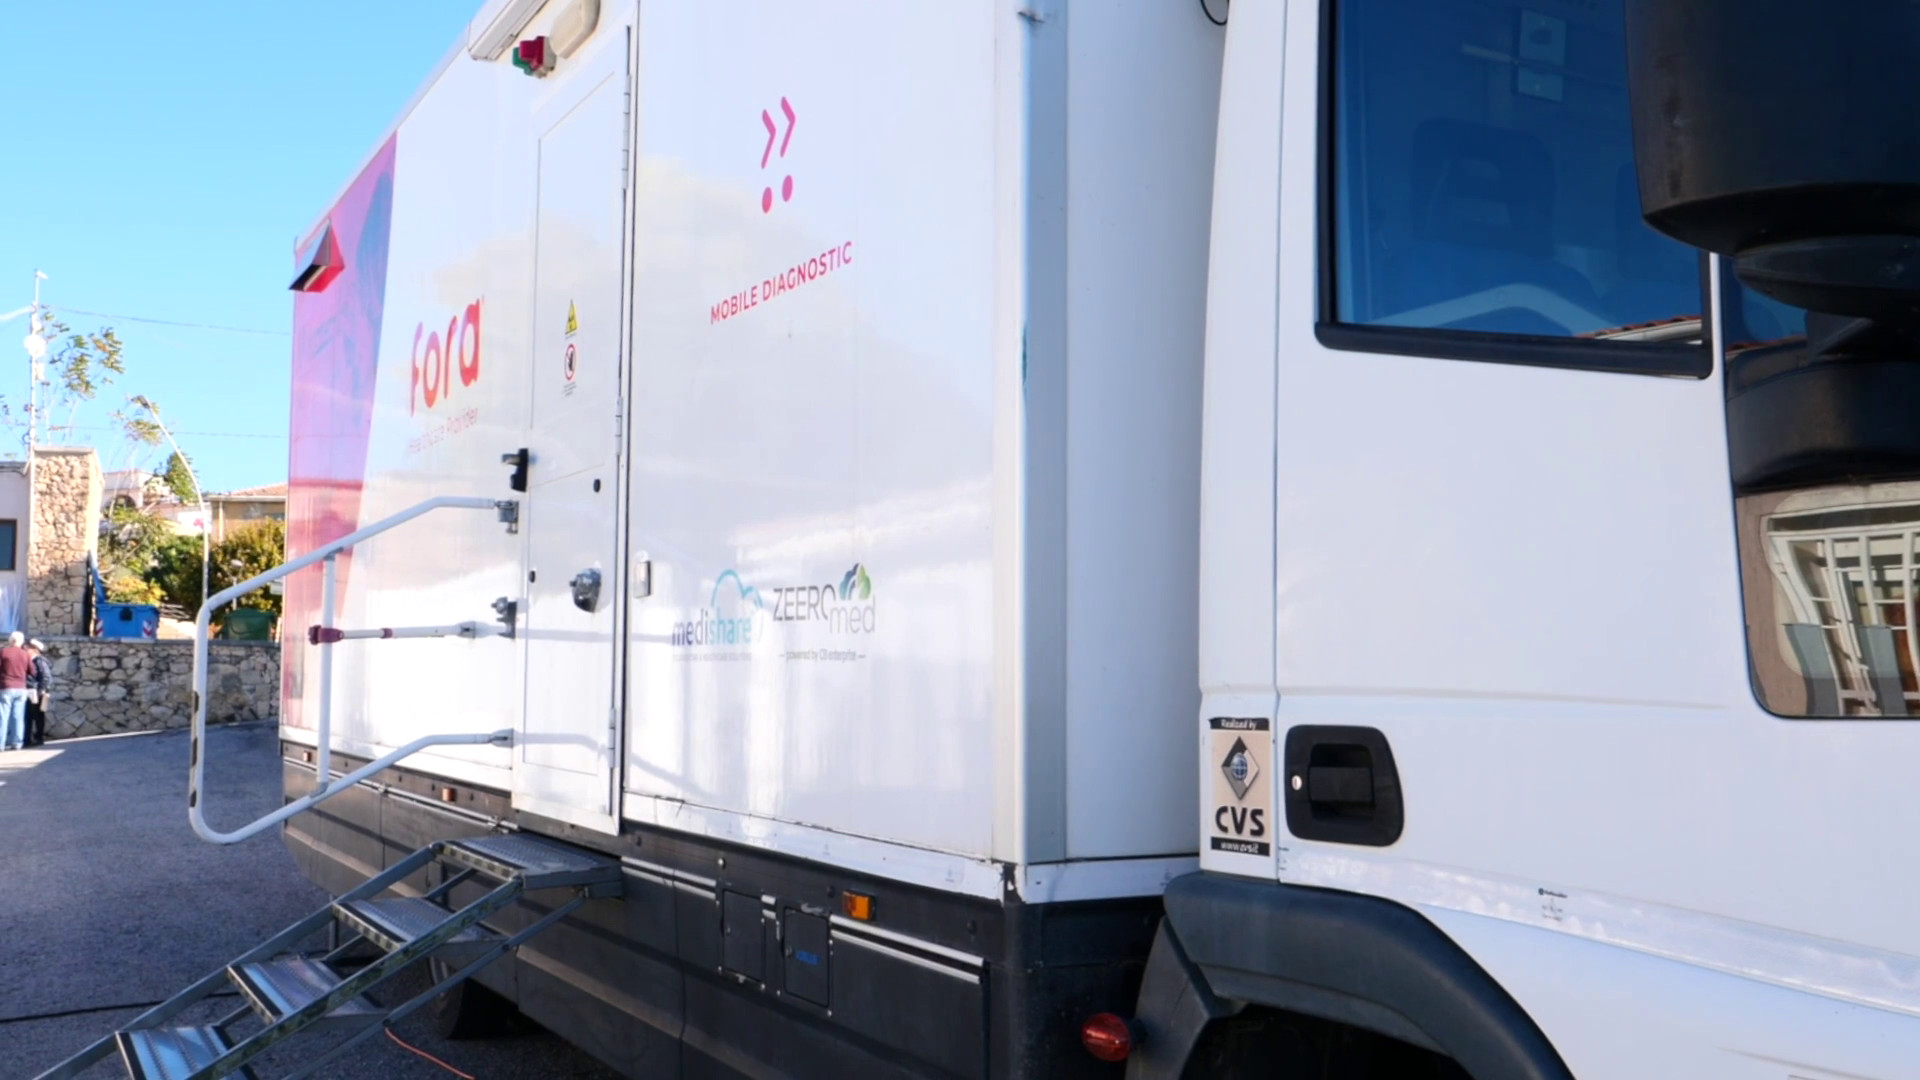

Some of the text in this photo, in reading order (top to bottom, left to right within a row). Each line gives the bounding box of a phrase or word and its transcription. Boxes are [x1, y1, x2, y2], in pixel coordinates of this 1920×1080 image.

[711, 241, 852, 325] MOBILE DIAGNOSTIC
[410, 298, 480, 418] fora
[672, 607, 752, 646] medishare
[1215, 805, 1264, 837] CVS
